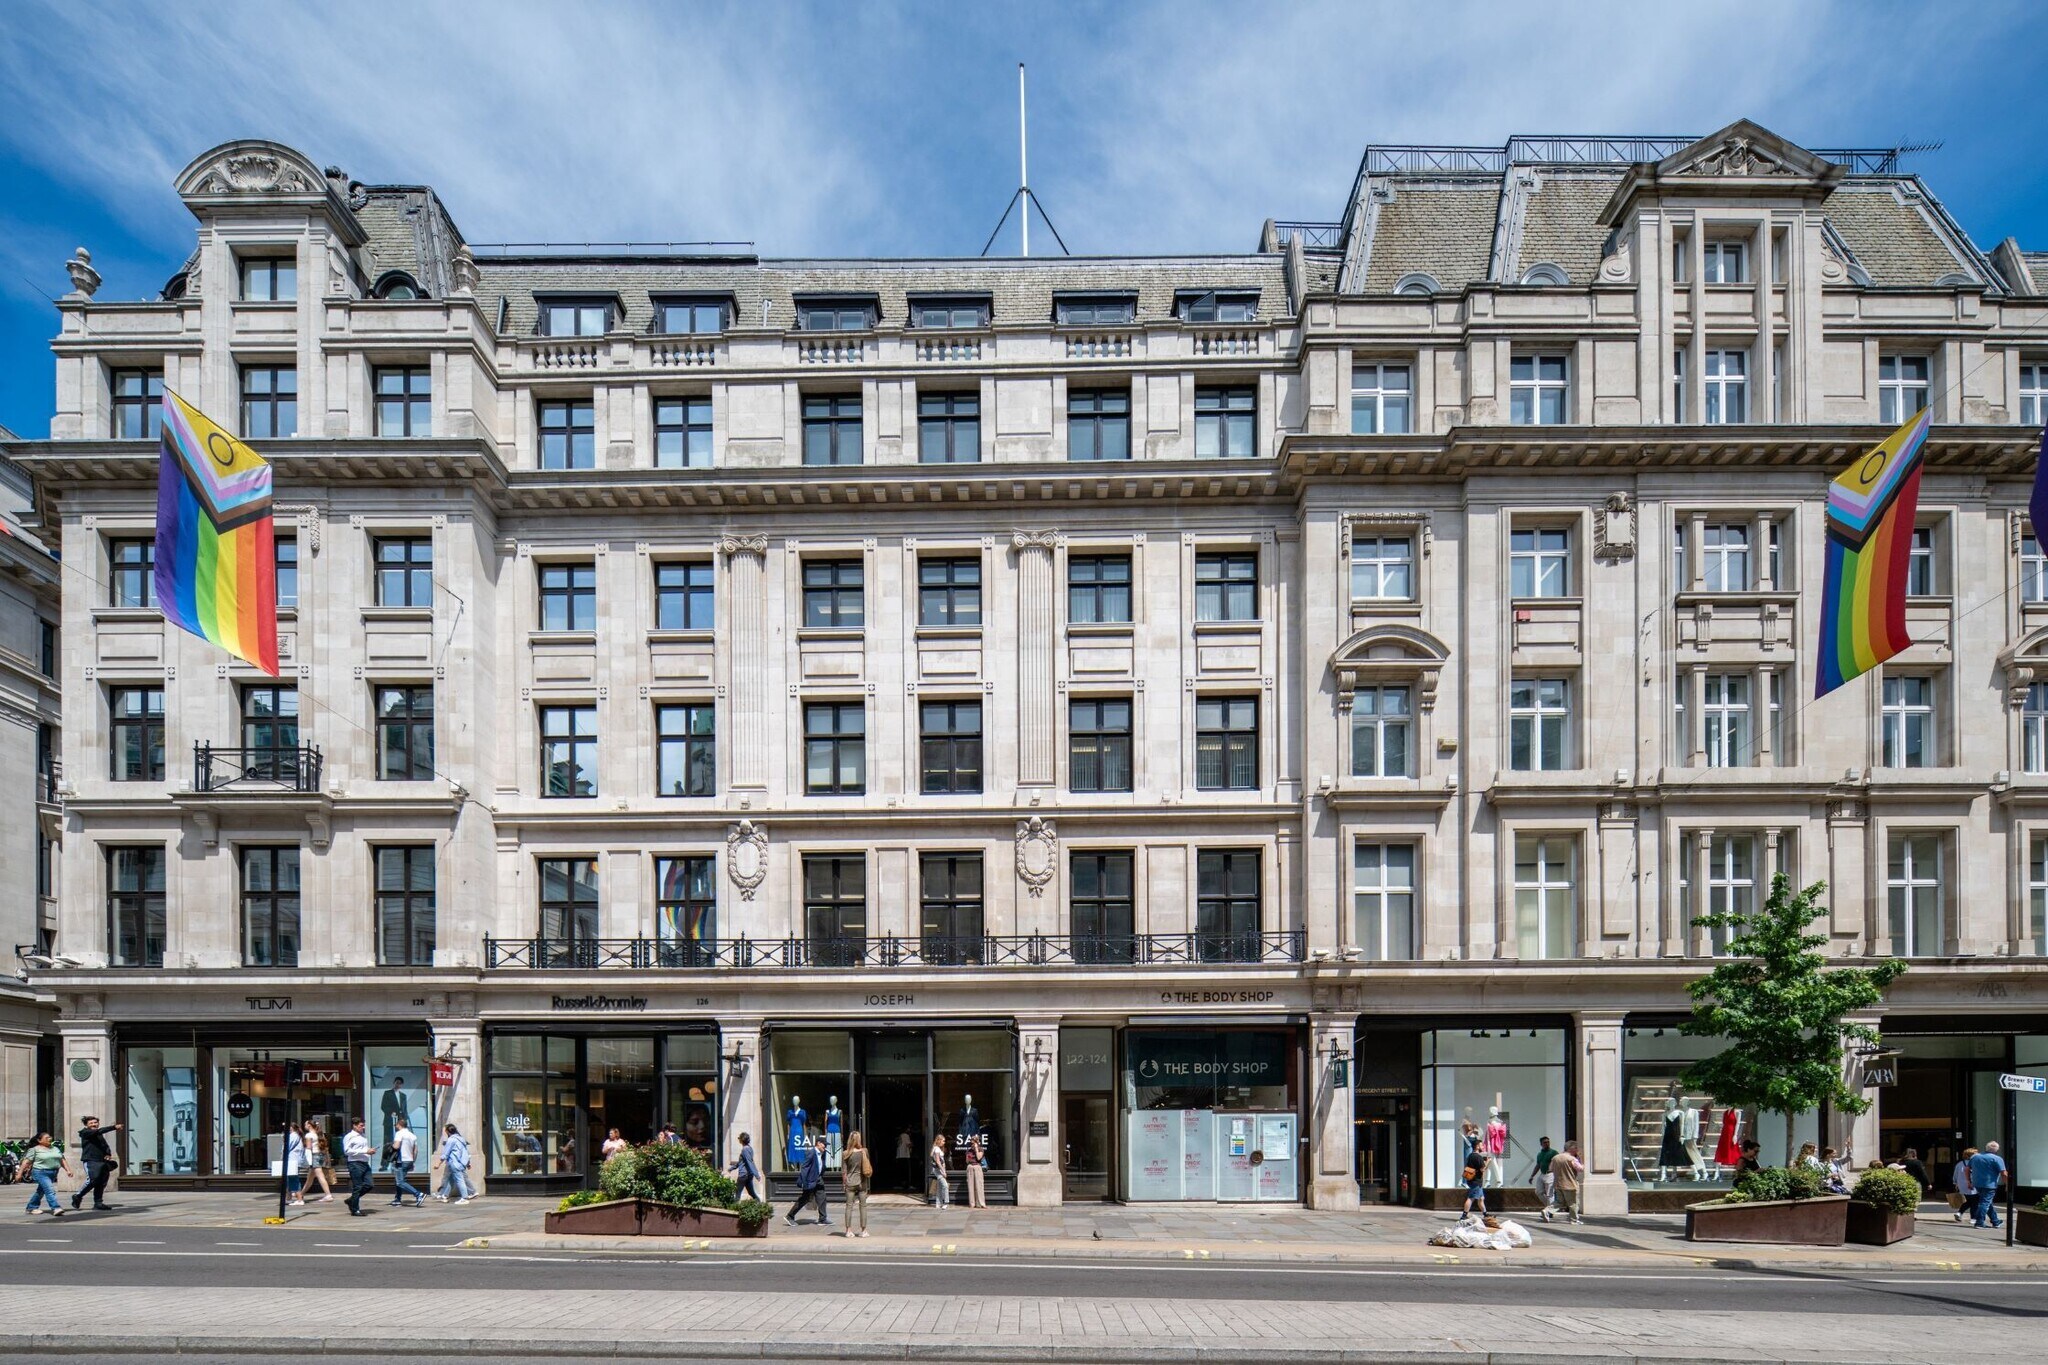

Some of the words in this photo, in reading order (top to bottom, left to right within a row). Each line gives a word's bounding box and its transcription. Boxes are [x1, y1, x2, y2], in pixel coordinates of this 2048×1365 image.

[245, 996, 292, 1010] TUMI
[697, 998, 709, 1006] 126
[864, 995, 914, 1006] JOSEPH
[1174, 992, 1199, 1003] THE
[1203, 991, 1237, 1003] BODY
[1240, 991, 1274, 1002] SHOP
[1067, 1054, 1107, 1065] 122-124
[1163, 1063, 1190, 1074] THE
[1193, 1062, 1229, 1074] BODY
[1232, 1062, 1269, 1074] SHOP
[302, 1069, 340, 1082] TUMI
[1864, 1068, 1894, 1084] ZARA
[506, 1113, 530, 1126] sale
